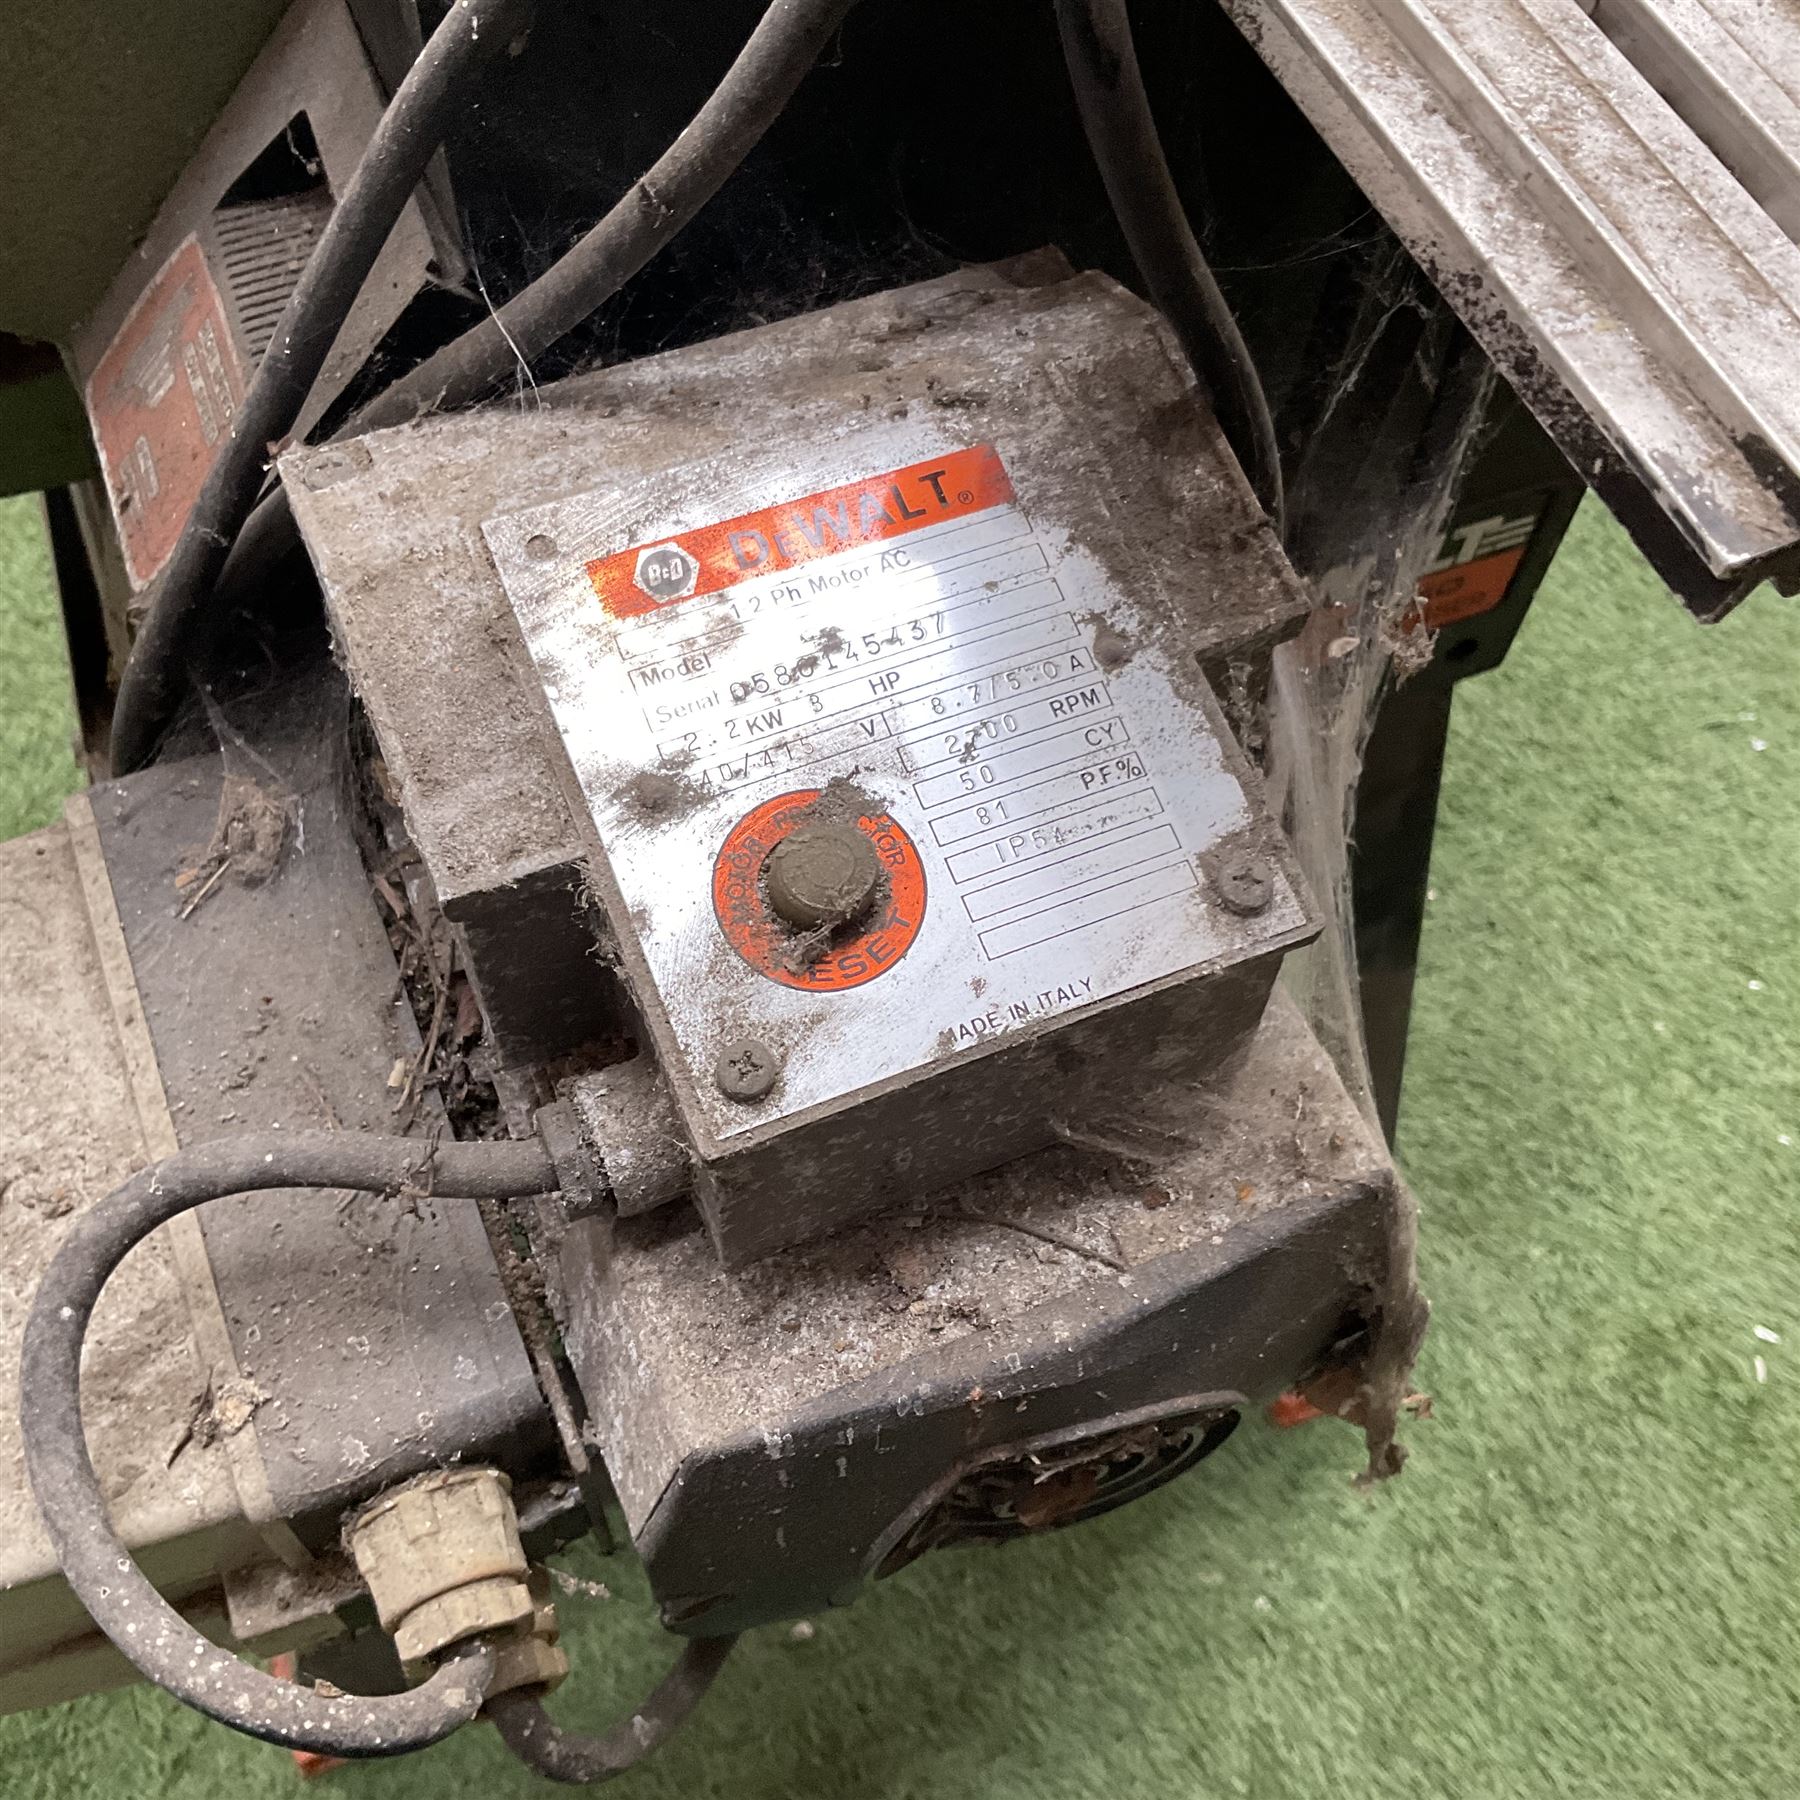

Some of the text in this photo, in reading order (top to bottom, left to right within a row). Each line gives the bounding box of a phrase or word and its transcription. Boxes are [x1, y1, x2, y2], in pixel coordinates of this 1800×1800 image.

[770, 586, 802, 605] Ph
[808, 566, 870, 595] Motor
[880, 551, 912, 573] AC
[640, 652, 711, 687] Model
[1069, 655, 1085, 672] A
[656, 690, 720, 723] Serial
[746, 709, 783, 735] KW
[868, 671, 900, 695] HP
[1049, 688, 1101, 719] RPM
[859, 718, 874, 738] V
[959, 721, 1115, 791] 50 CY
[976, 800, 1009, 825] 81
[798, 906, 910, 983] ESET
[1008, 1000, 1030, 1021] IN
[1037, 976, 1093, 1010] ITALY
